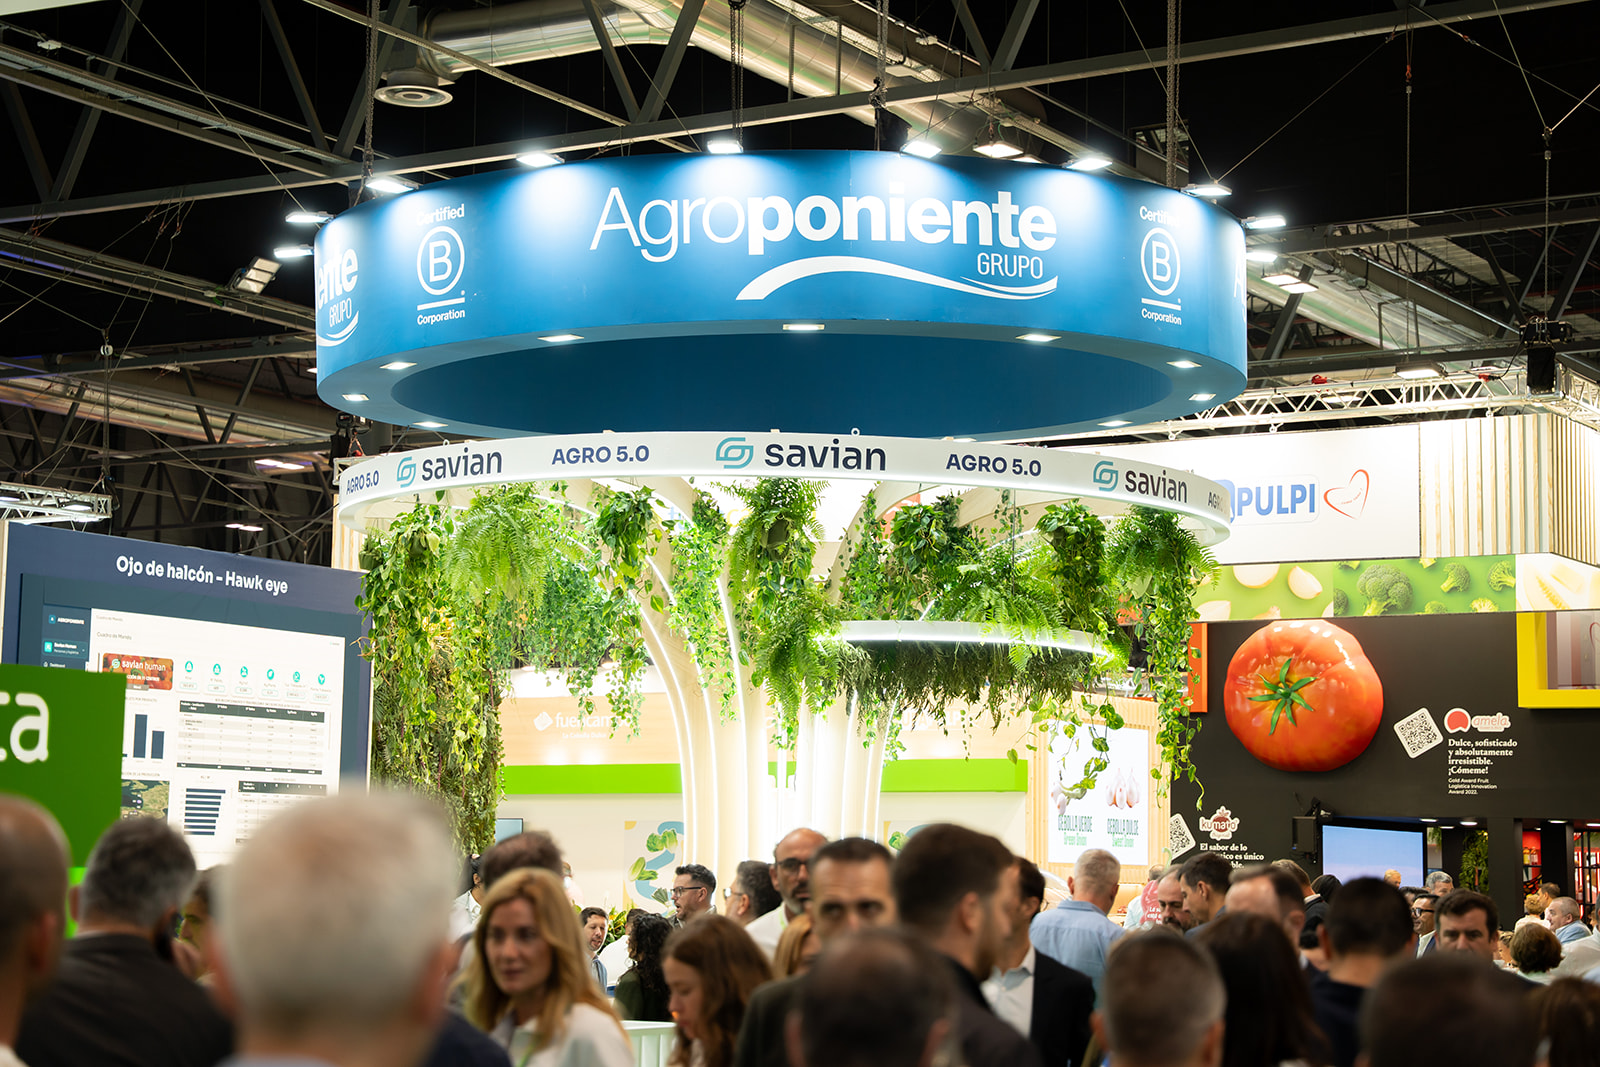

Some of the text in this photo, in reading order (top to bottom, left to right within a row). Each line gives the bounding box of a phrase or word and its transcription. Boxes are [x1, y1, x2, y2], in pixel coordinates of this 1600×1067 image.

[416, 204, 464, 226] Certified
[589, 182, 1058, 263] Agroponiente
[977, 252, 1044, 279] GRUPO
[329, 297, 352, 328] GRUPO
[417, 309, 466, 325] Corporation
[1141, 308, 1182, 325] Corporation
[421, 447, 503, 482] savian
[551, 445, 650, 465] AGRO 5.0
[764, 438, 886, 471] savian
[945, 453, 1042, 477] AGRO 5.0
[346, 470, 380, 495] AGRO 5.0
[1124, 469, 1188, 504] savian
[1237, 483, 1315, 517] PULPI
[116, 555, 144, 577] Ojo
[145, 560, 164, 577] de
[166, 562, 214, 584] halcón
[225, 570, 263, 591] Hawk
[265, 578, 288, 597] eye
[144, 661, 166, 672] human
[1448, 738, 1518, 748] Dulce, sofisticado
[1448, 747, 1513, 757] y absolutamente
[1448, 756, 1494, 765] irresistible.
[1448, 766, 1489, 776] ¡Cómeme!
[1200, 842, 1248, 851] El sabor de lo
[1243, 852, 1264, 861] único
